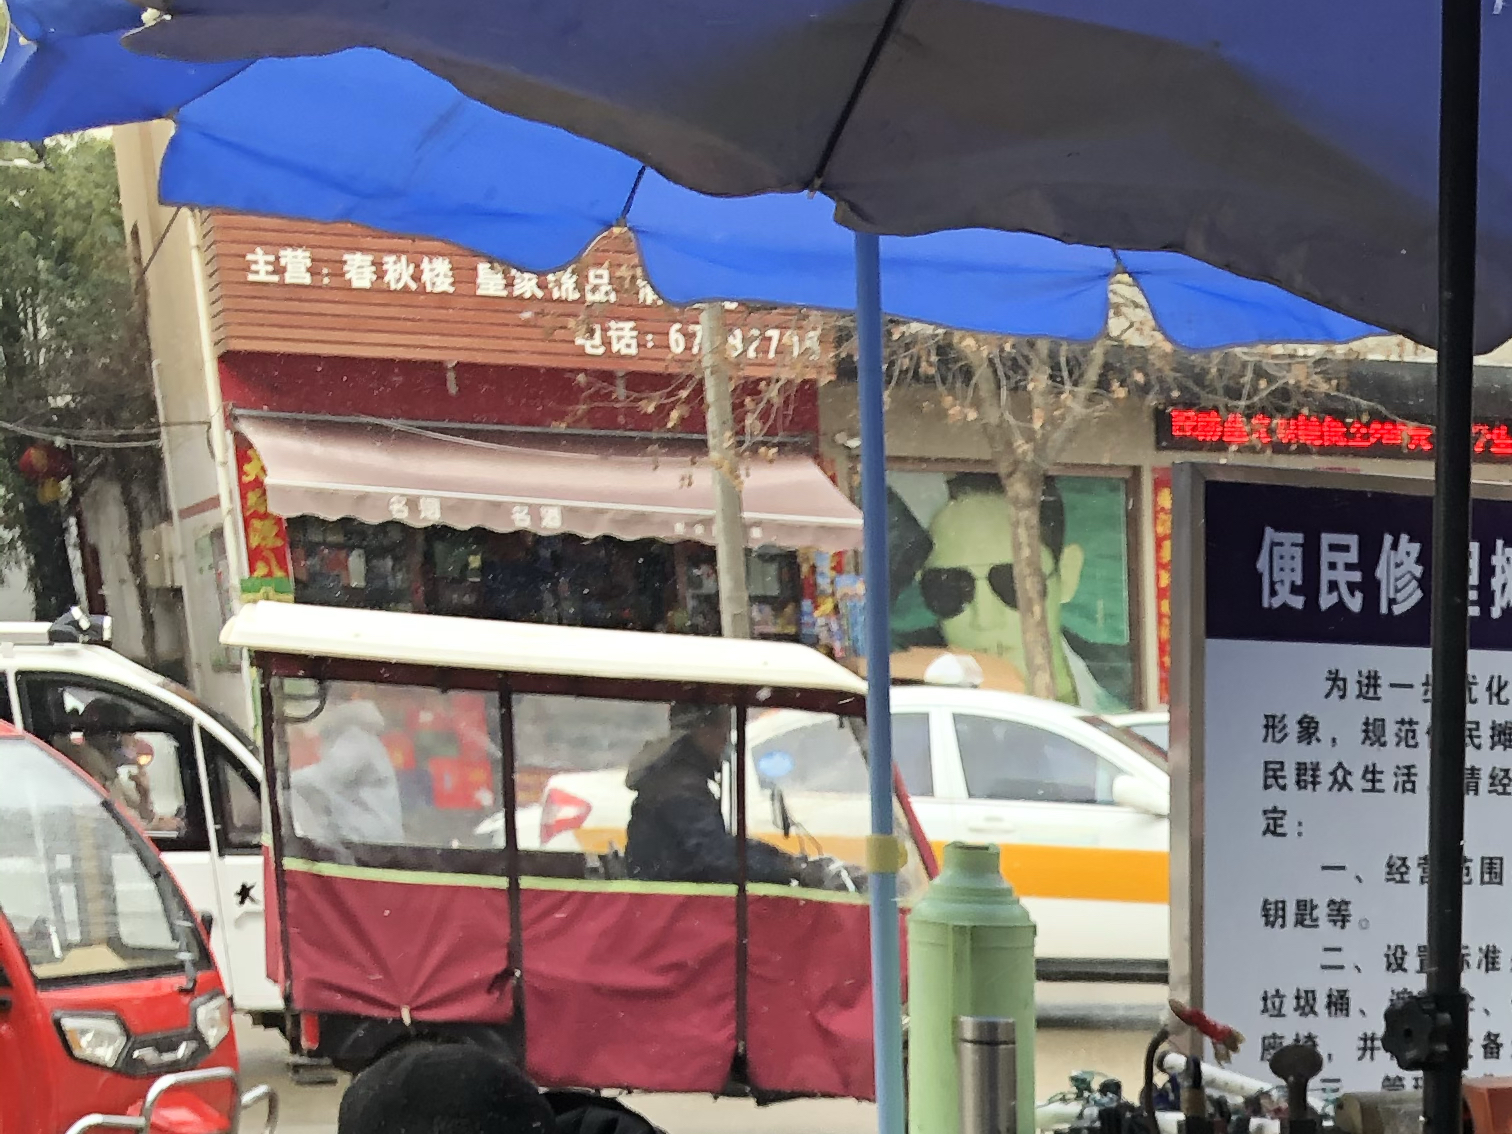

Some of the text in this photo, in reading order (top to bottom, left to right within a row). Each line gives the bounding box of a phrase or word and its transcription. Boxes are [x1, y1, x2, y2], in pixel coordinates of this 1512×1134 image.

[1262, 806, 1303, 837] 定：
[1261, 898, 1370, 930] 钥匙等。
